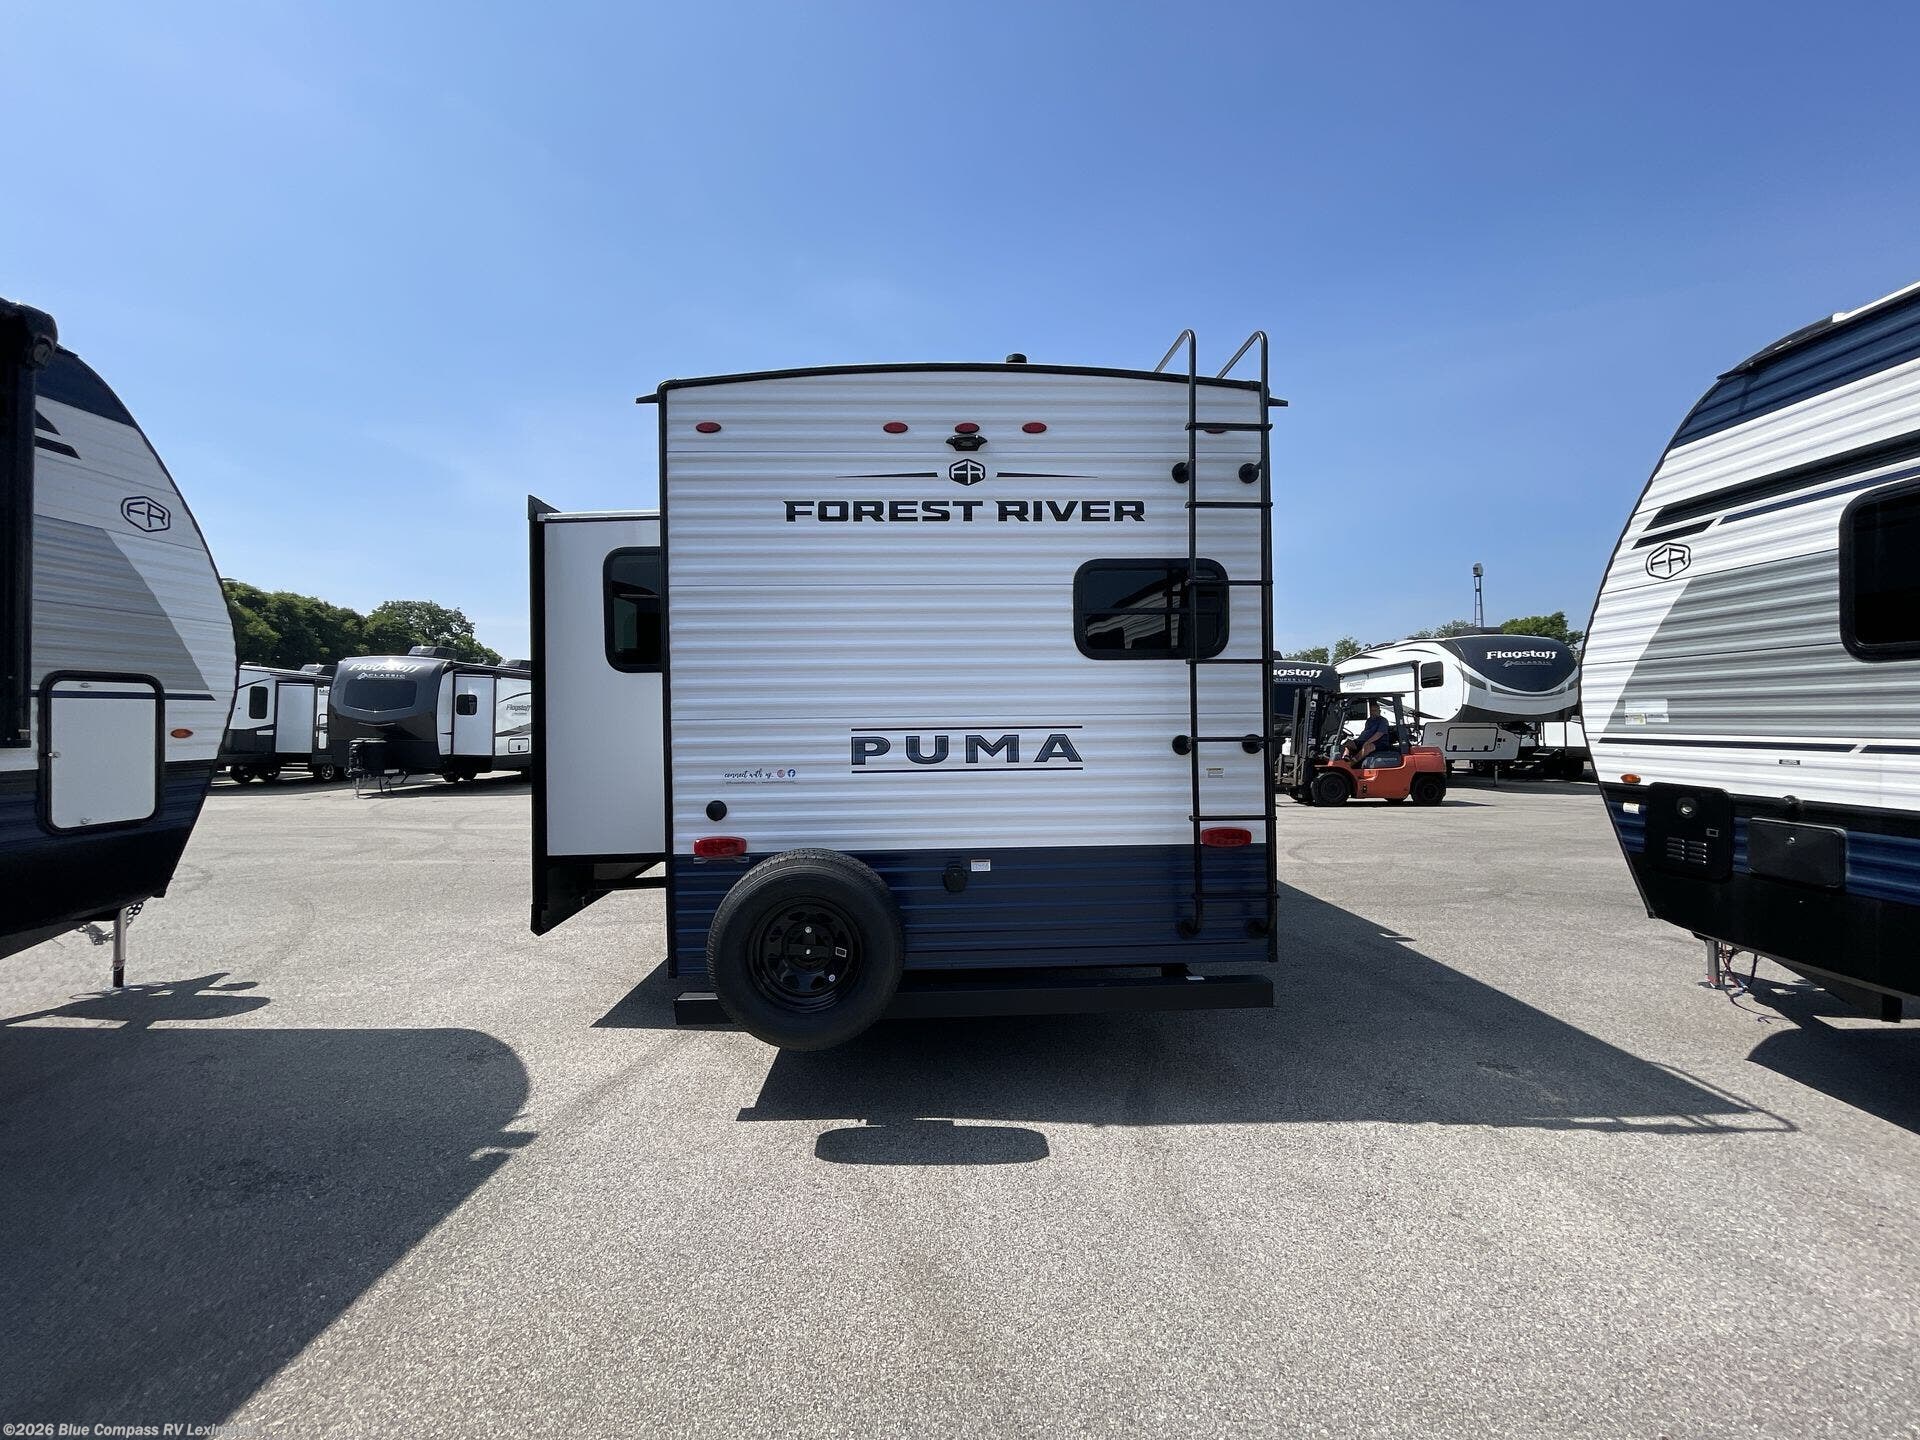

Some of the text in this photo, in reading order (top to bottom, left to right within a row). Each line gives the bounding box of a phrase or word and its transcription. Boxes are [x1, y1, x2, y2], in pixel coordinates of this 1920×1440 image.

[784, 500, 1146, 523] FOREST RIVER
[1486, 650, 1557, 659] Flagstaff
[1273, 668, 1323, 678] gstaff
[851, 733, 1083, 765] PUMA
